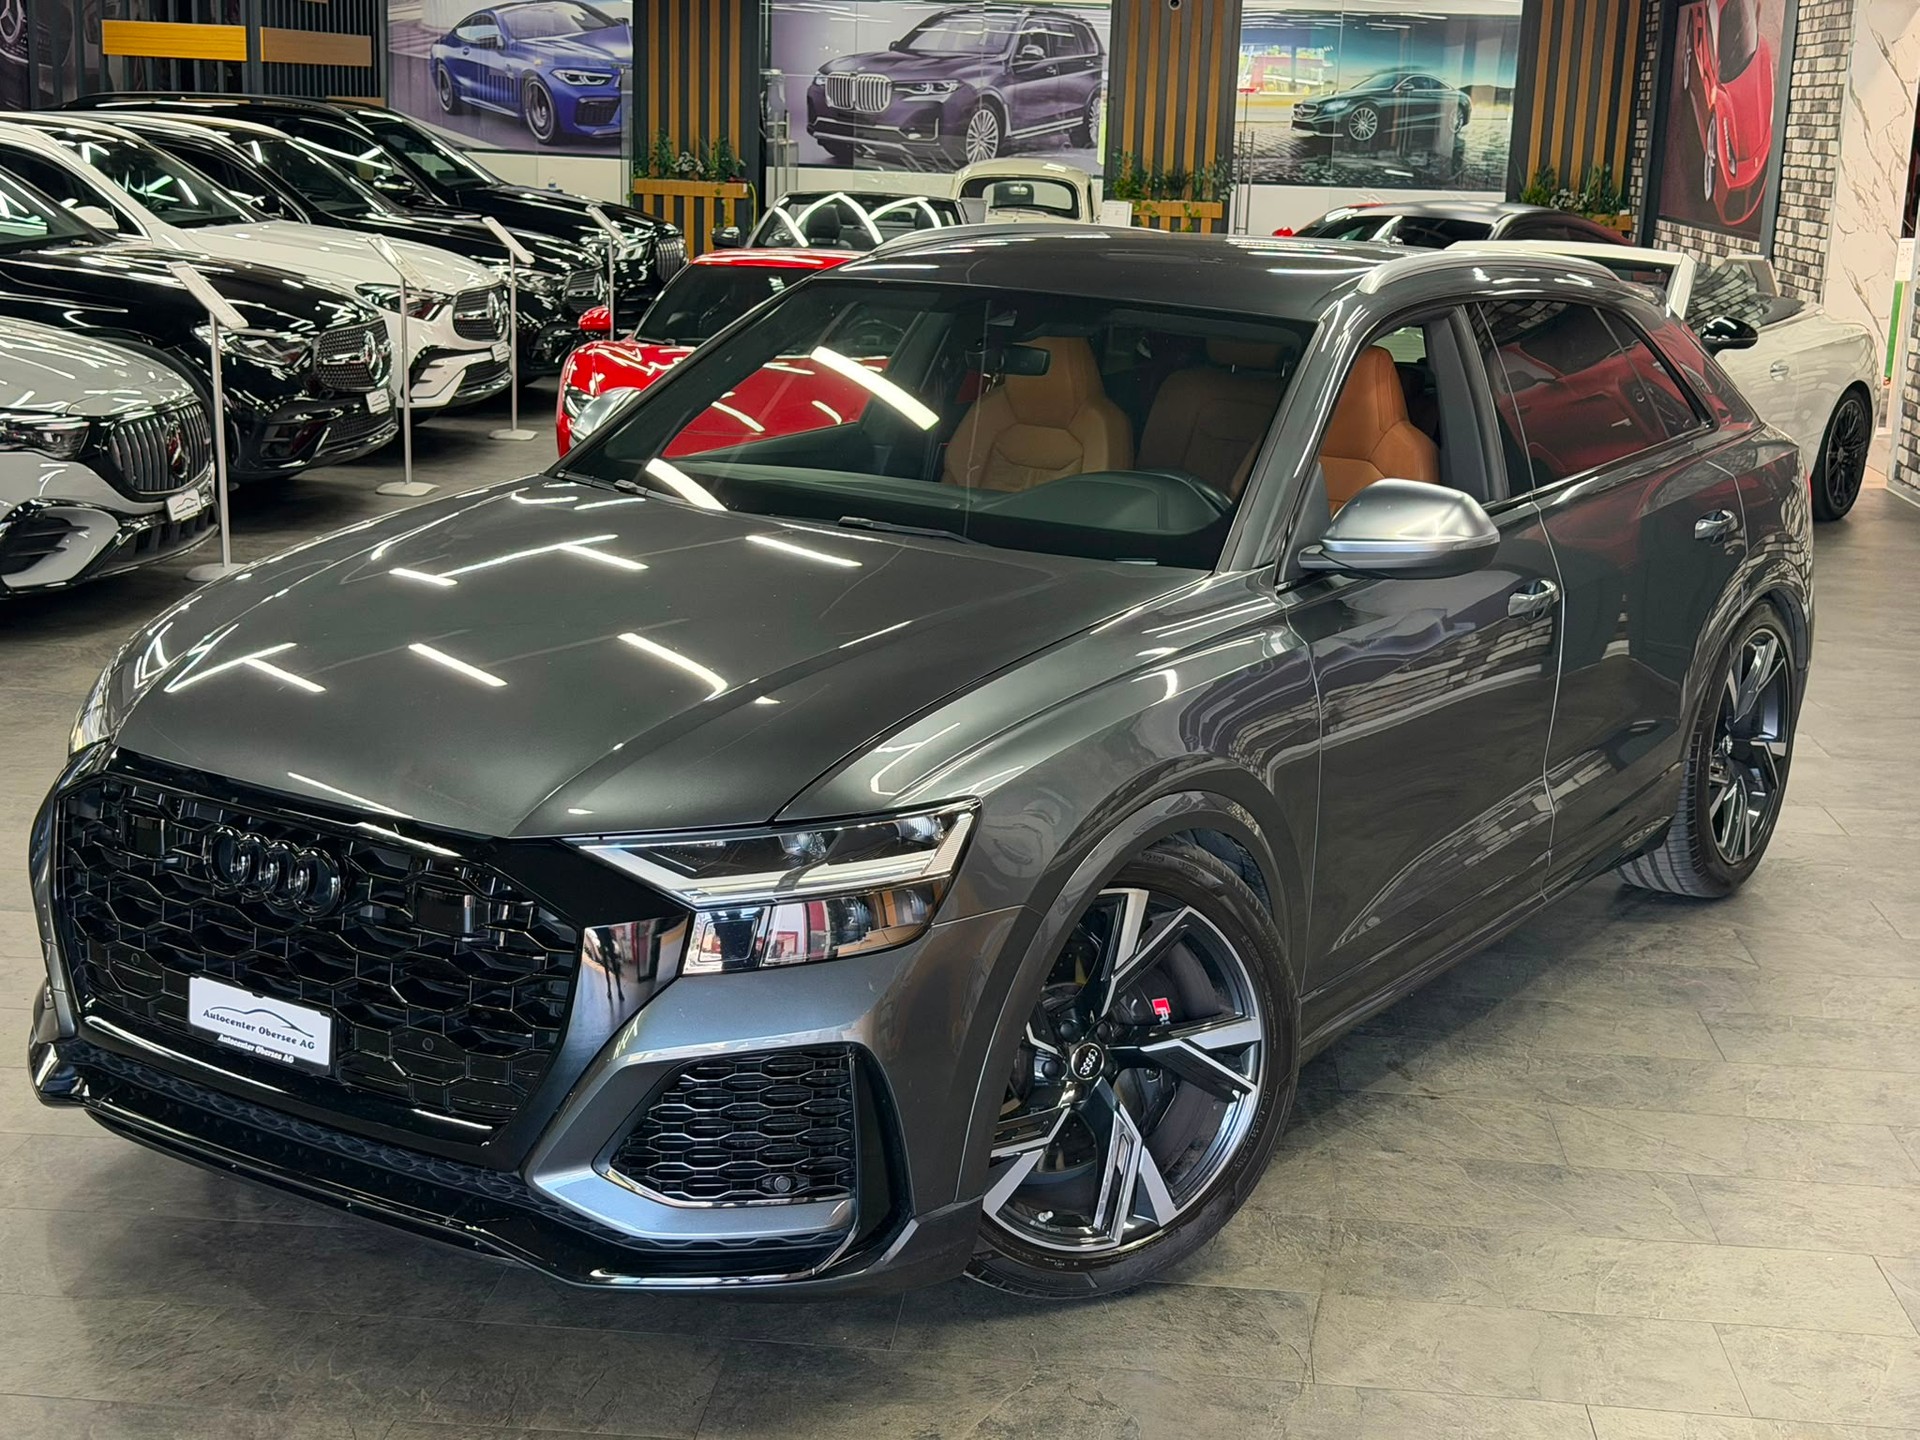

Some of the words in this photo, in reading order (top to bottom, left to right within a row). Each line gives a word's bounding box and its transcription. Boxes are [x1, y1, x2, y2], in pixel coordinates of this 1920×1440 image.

[202, 1009, 256, 1033] Autocenter
[258, 1026, 297, 1045] Obersee
[299, 1039, 315, 1050] AG
[217, 1034, 255, 1052] Autocenter
[255, 1045, 283, 1060] Obersee
[283, 1052, 295, 1063] AG
